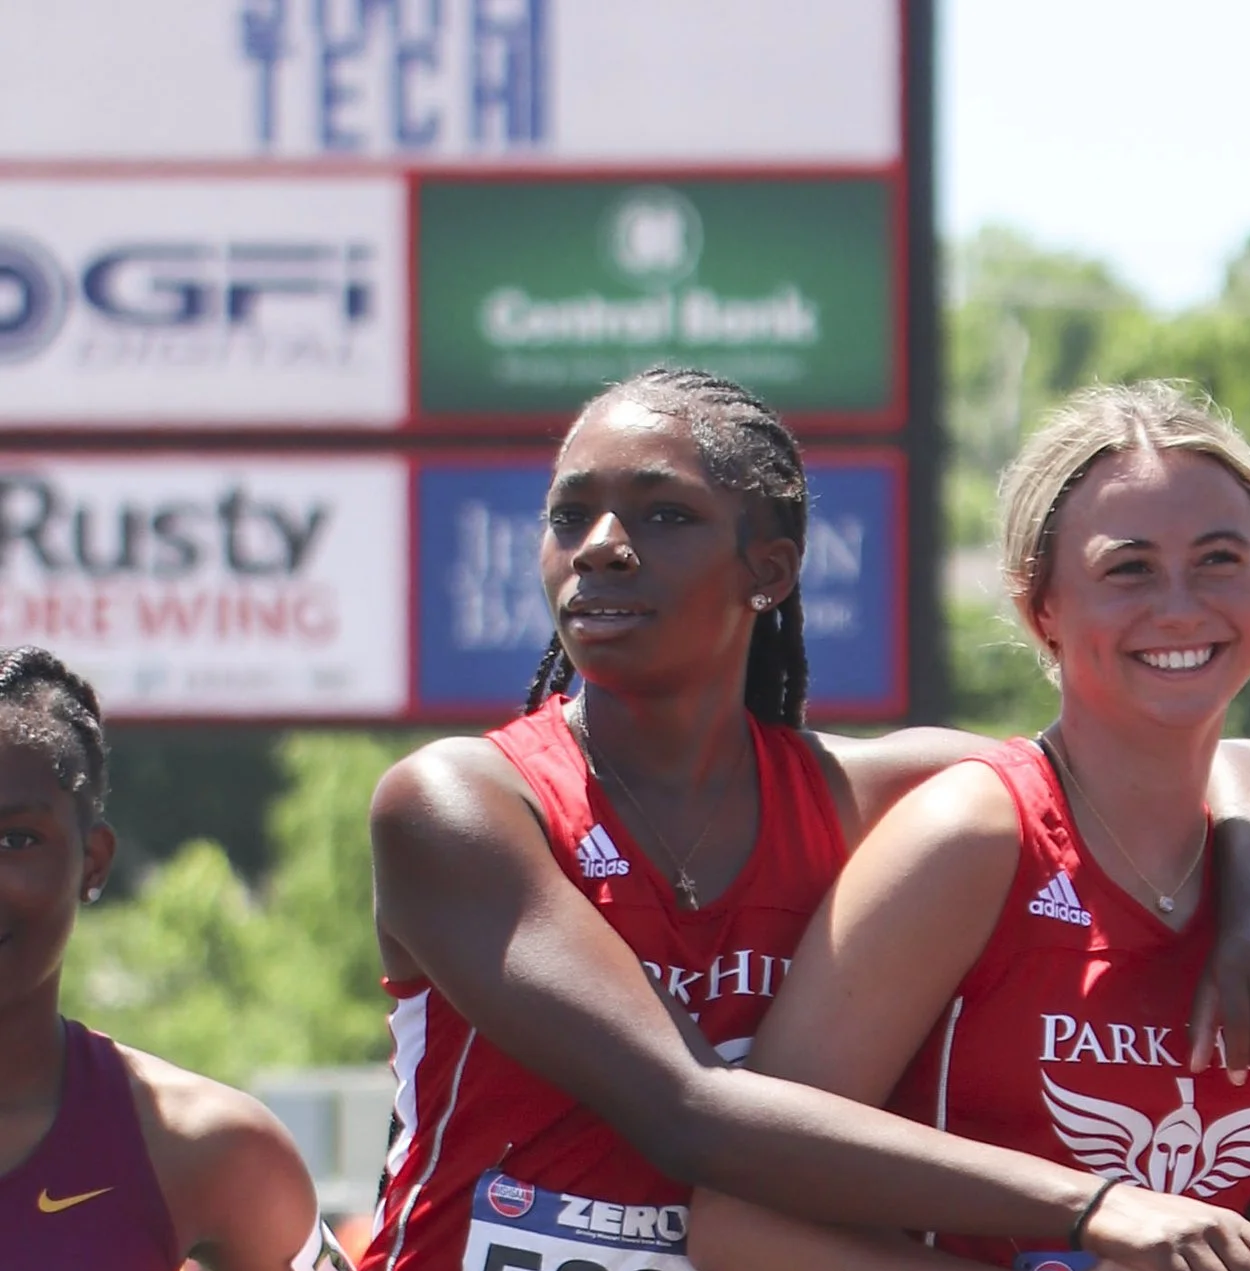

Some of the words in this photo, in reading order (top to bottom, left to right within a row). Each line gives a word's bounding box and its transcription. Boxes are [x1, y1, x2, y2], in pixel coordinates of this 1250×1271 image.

[1029, 899, 1092, 926] adidas
[1039, 1013, 1183, 1067] PARK
[557, 1192, 690, 1242] ZERO
